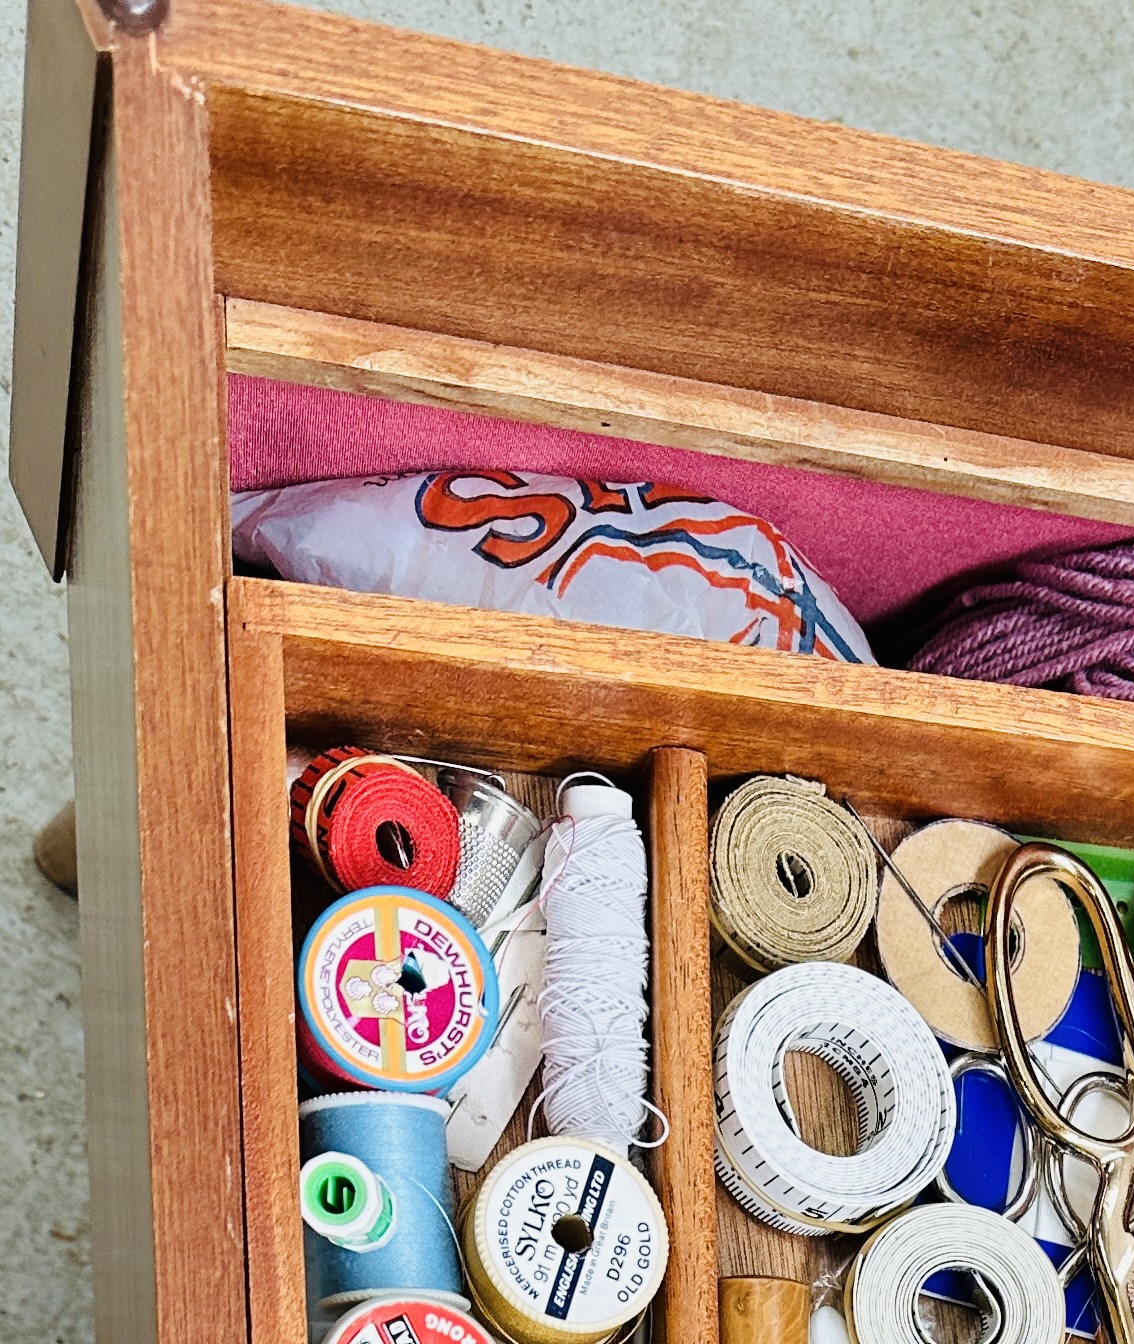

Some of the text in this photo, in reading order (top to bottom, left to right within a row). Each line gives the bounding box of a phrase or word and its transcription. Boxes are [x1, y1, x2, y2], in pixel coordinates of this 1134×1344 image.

[320, 984, 381, 1063] POLYESTER
[413, 918, 473, 1067] DEWHURST'S
[514, 1178, 556, 1262] SYLKO
[585, 1171, 605, 1202] LTD
[496, 1158, 582, 1301] MERCERISED COTTON THREAD
[532, 1262, 550, 1284] 91
[544, 1243, 559, 1264] m
[562, 1176, 579, 1203] yd
[579, 1274, 596, 1297] Made
[599, 1199, 617, 1234] Britain
[606, 1233, 632, 1282] D296
[616, 1221, 652, 1304] OLD GOLD
